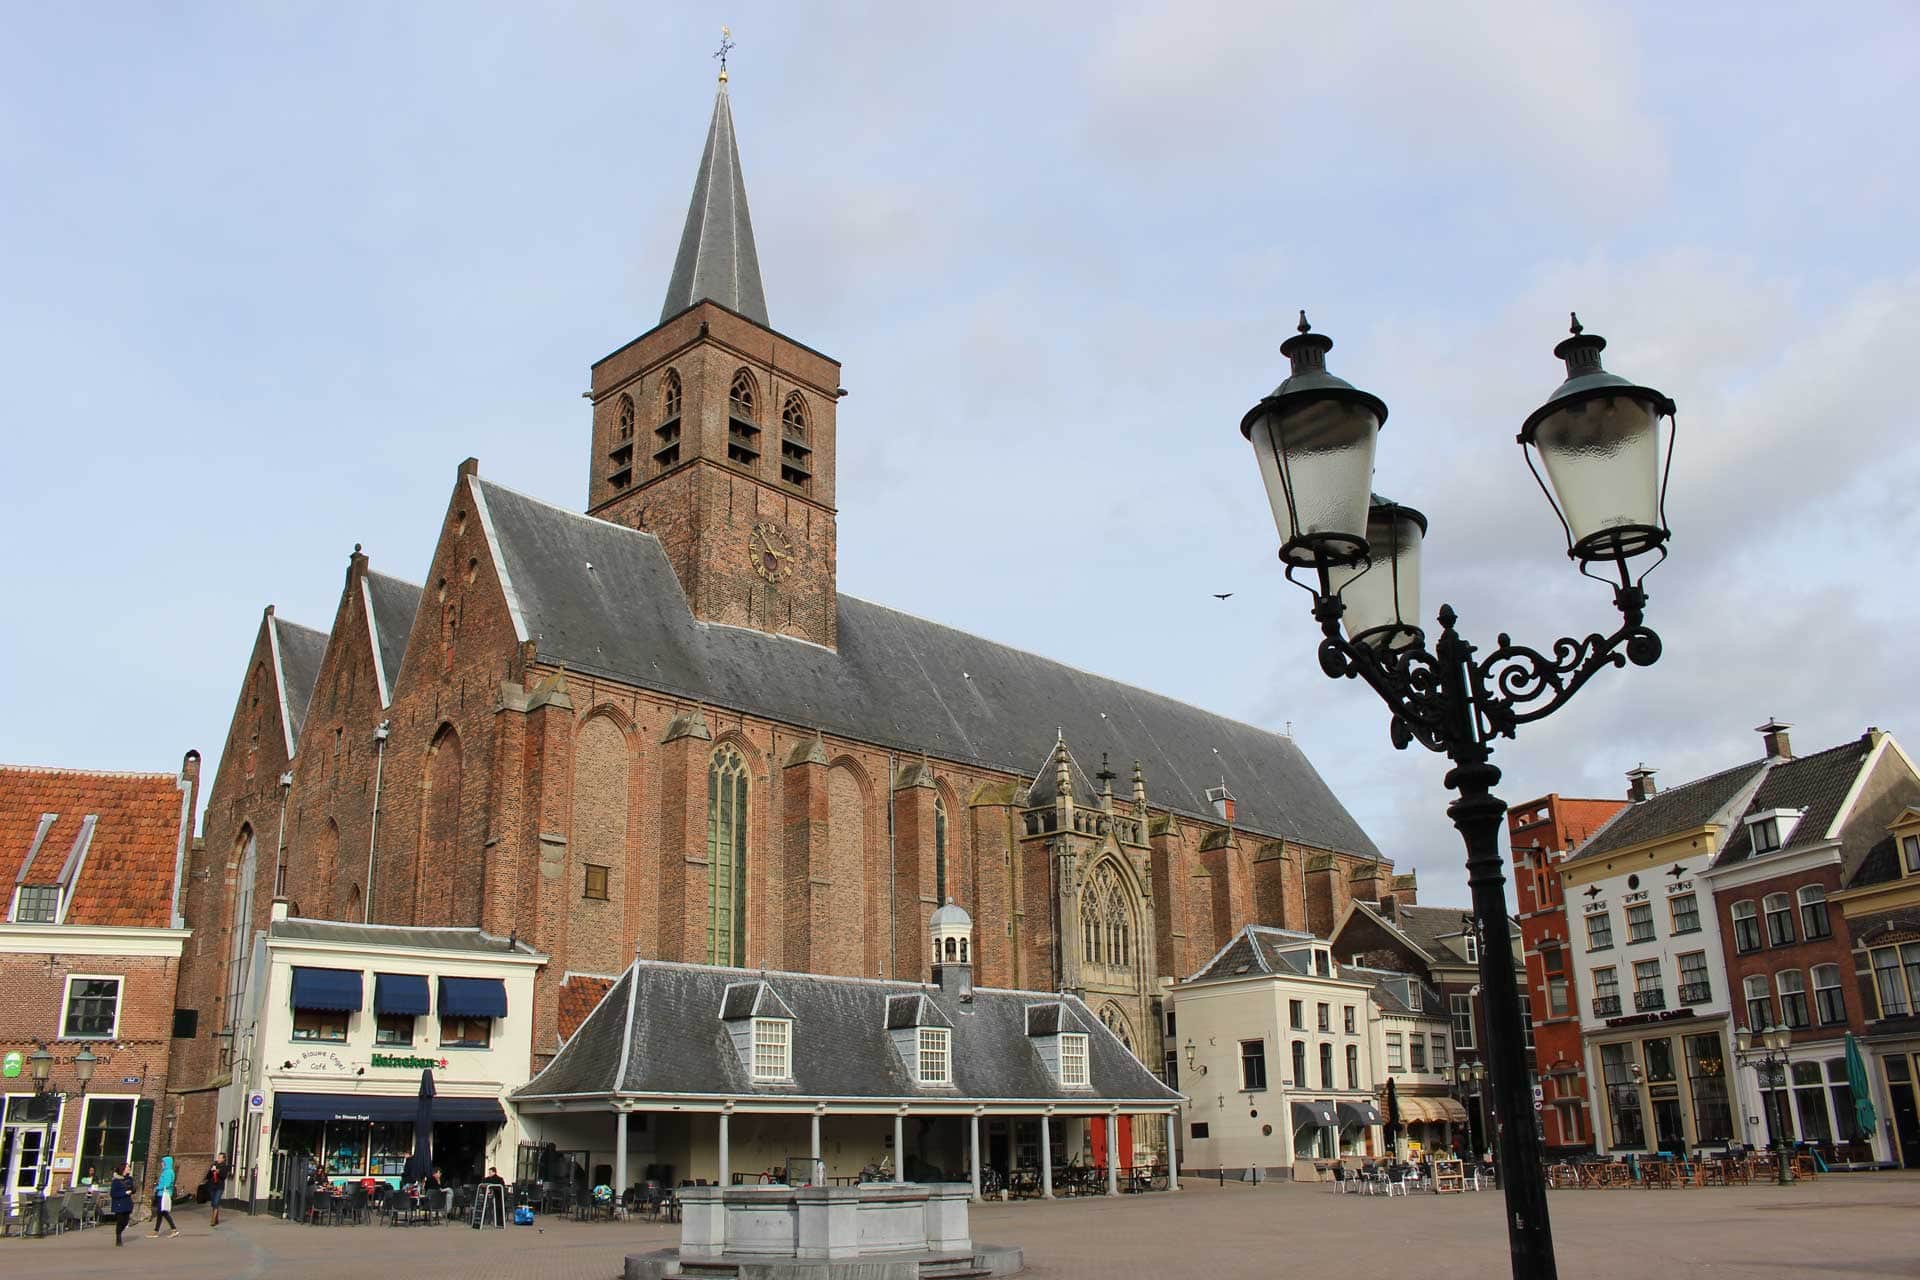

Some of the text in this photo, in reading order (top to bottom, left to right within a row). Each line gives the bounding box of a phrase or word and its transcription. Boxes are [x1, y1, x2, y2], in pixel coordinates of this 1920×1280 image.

[302, 1050, 327, 1059] Blauwe
[330, 1052, 346, 1071] Engel
[371, 1053, 434, 1068] Heineken
